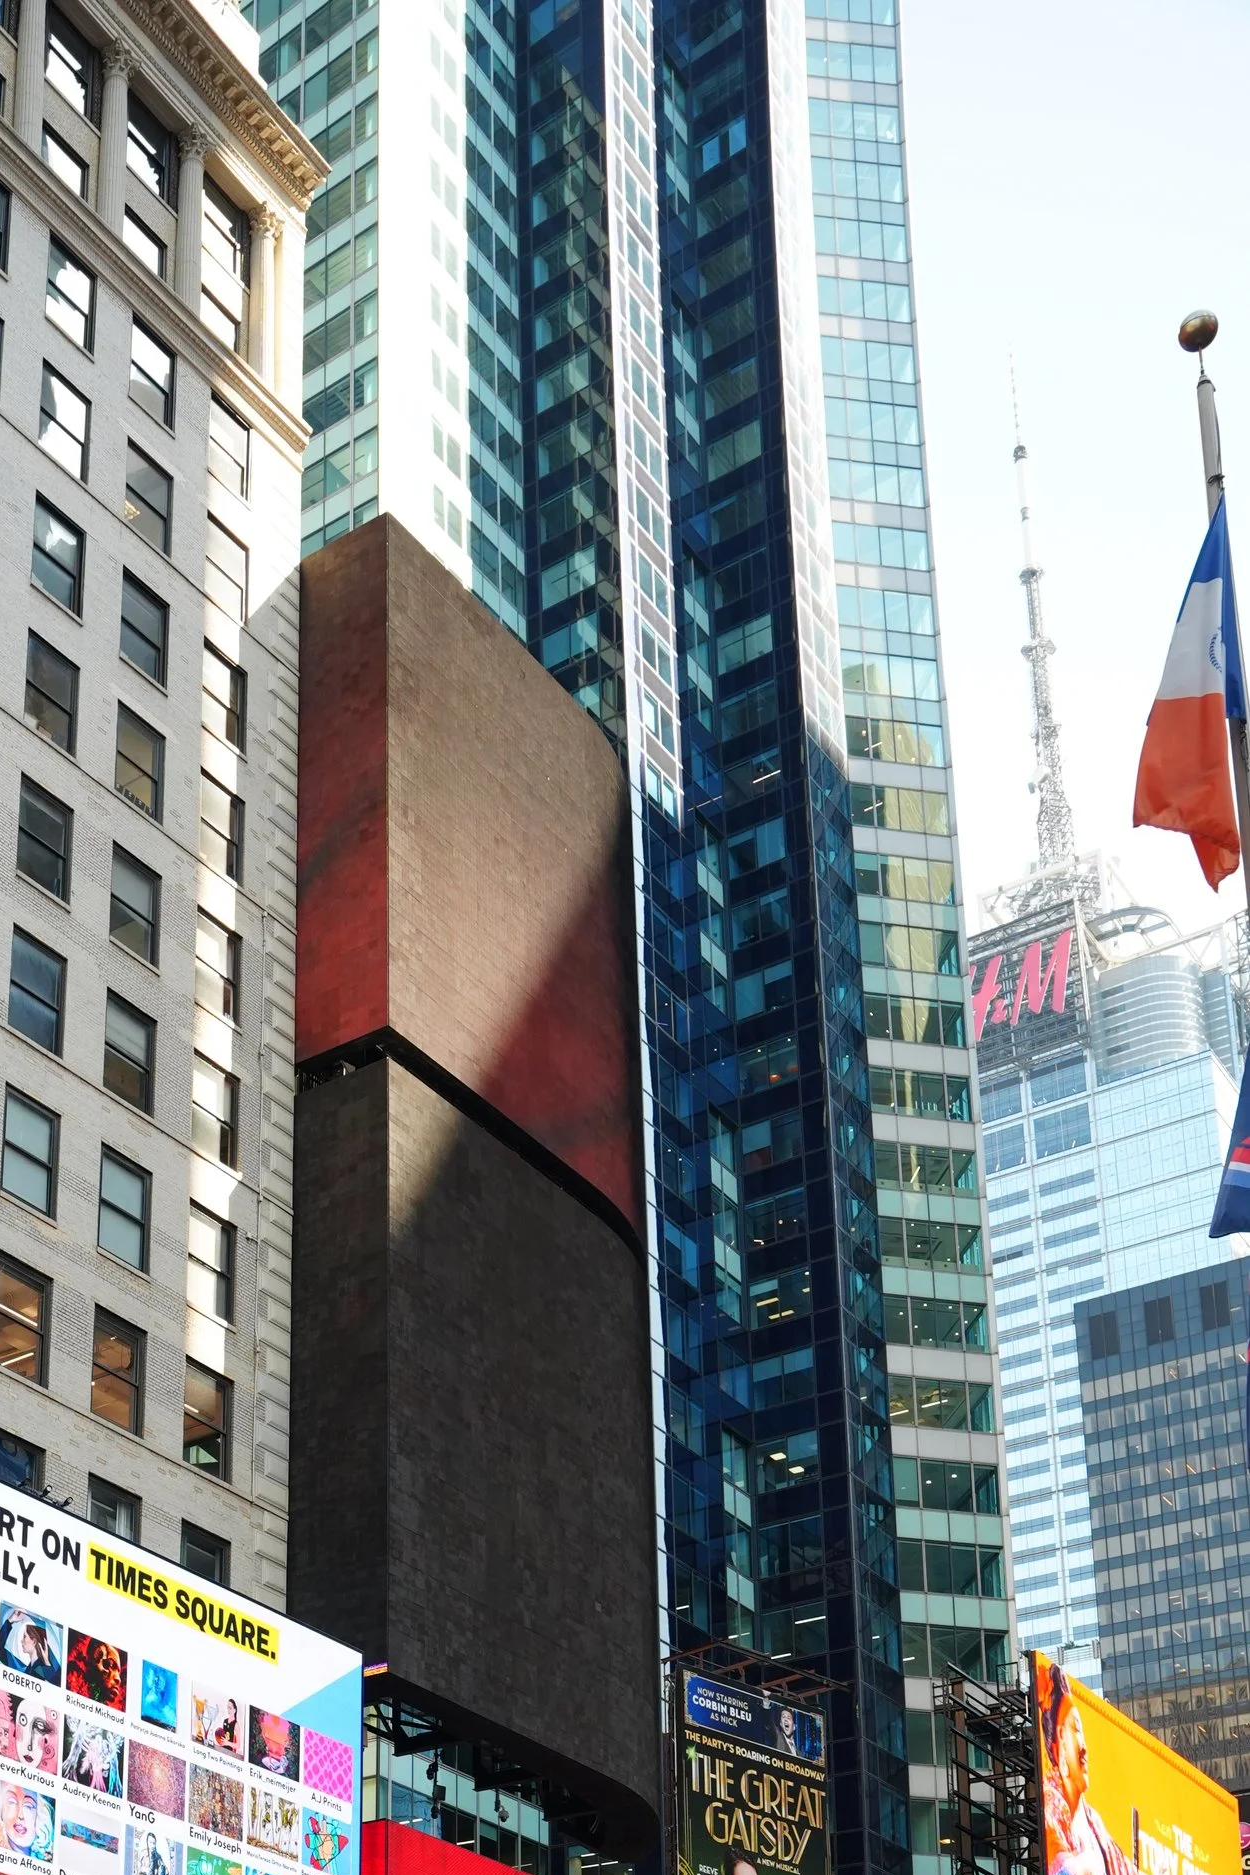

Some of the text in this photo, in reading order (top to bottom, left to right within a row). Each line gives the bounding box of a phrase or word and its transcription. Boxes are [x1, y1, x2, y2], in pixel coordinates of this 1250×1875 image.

[969, 928, 1073, 1041] H&M
[42, 1528, 81, 1572] ON
[90, 1548, 168, 1610] TIMES
[175, 1589, 276, 1661] SQUARE.
[3, 1670, 42, 1693] ROBERTO
[692, 1695, 751, 1722] CORBIN BLEU
[697, 1687, 748, 1711] NOW STARRING
[710, 1712, 738, 1728] AS NICK
[684, 1730, 825, 1782] THE PARTY'S ROARING ON BROADWAY
[249, 1768, 296, 1793] Erik_neimeijer
[687, 1752, 826, 1829] THE GREAT
[62, 1783, 121, 1811] Audrey Keenan
[129, 1804, 155, 1824] YanG
[189, 1827, 242, 1855] Emily Joseph
[705, 1802, 811, 1865] GATSBY
[1172, 1824, 1194, 1858] THE
